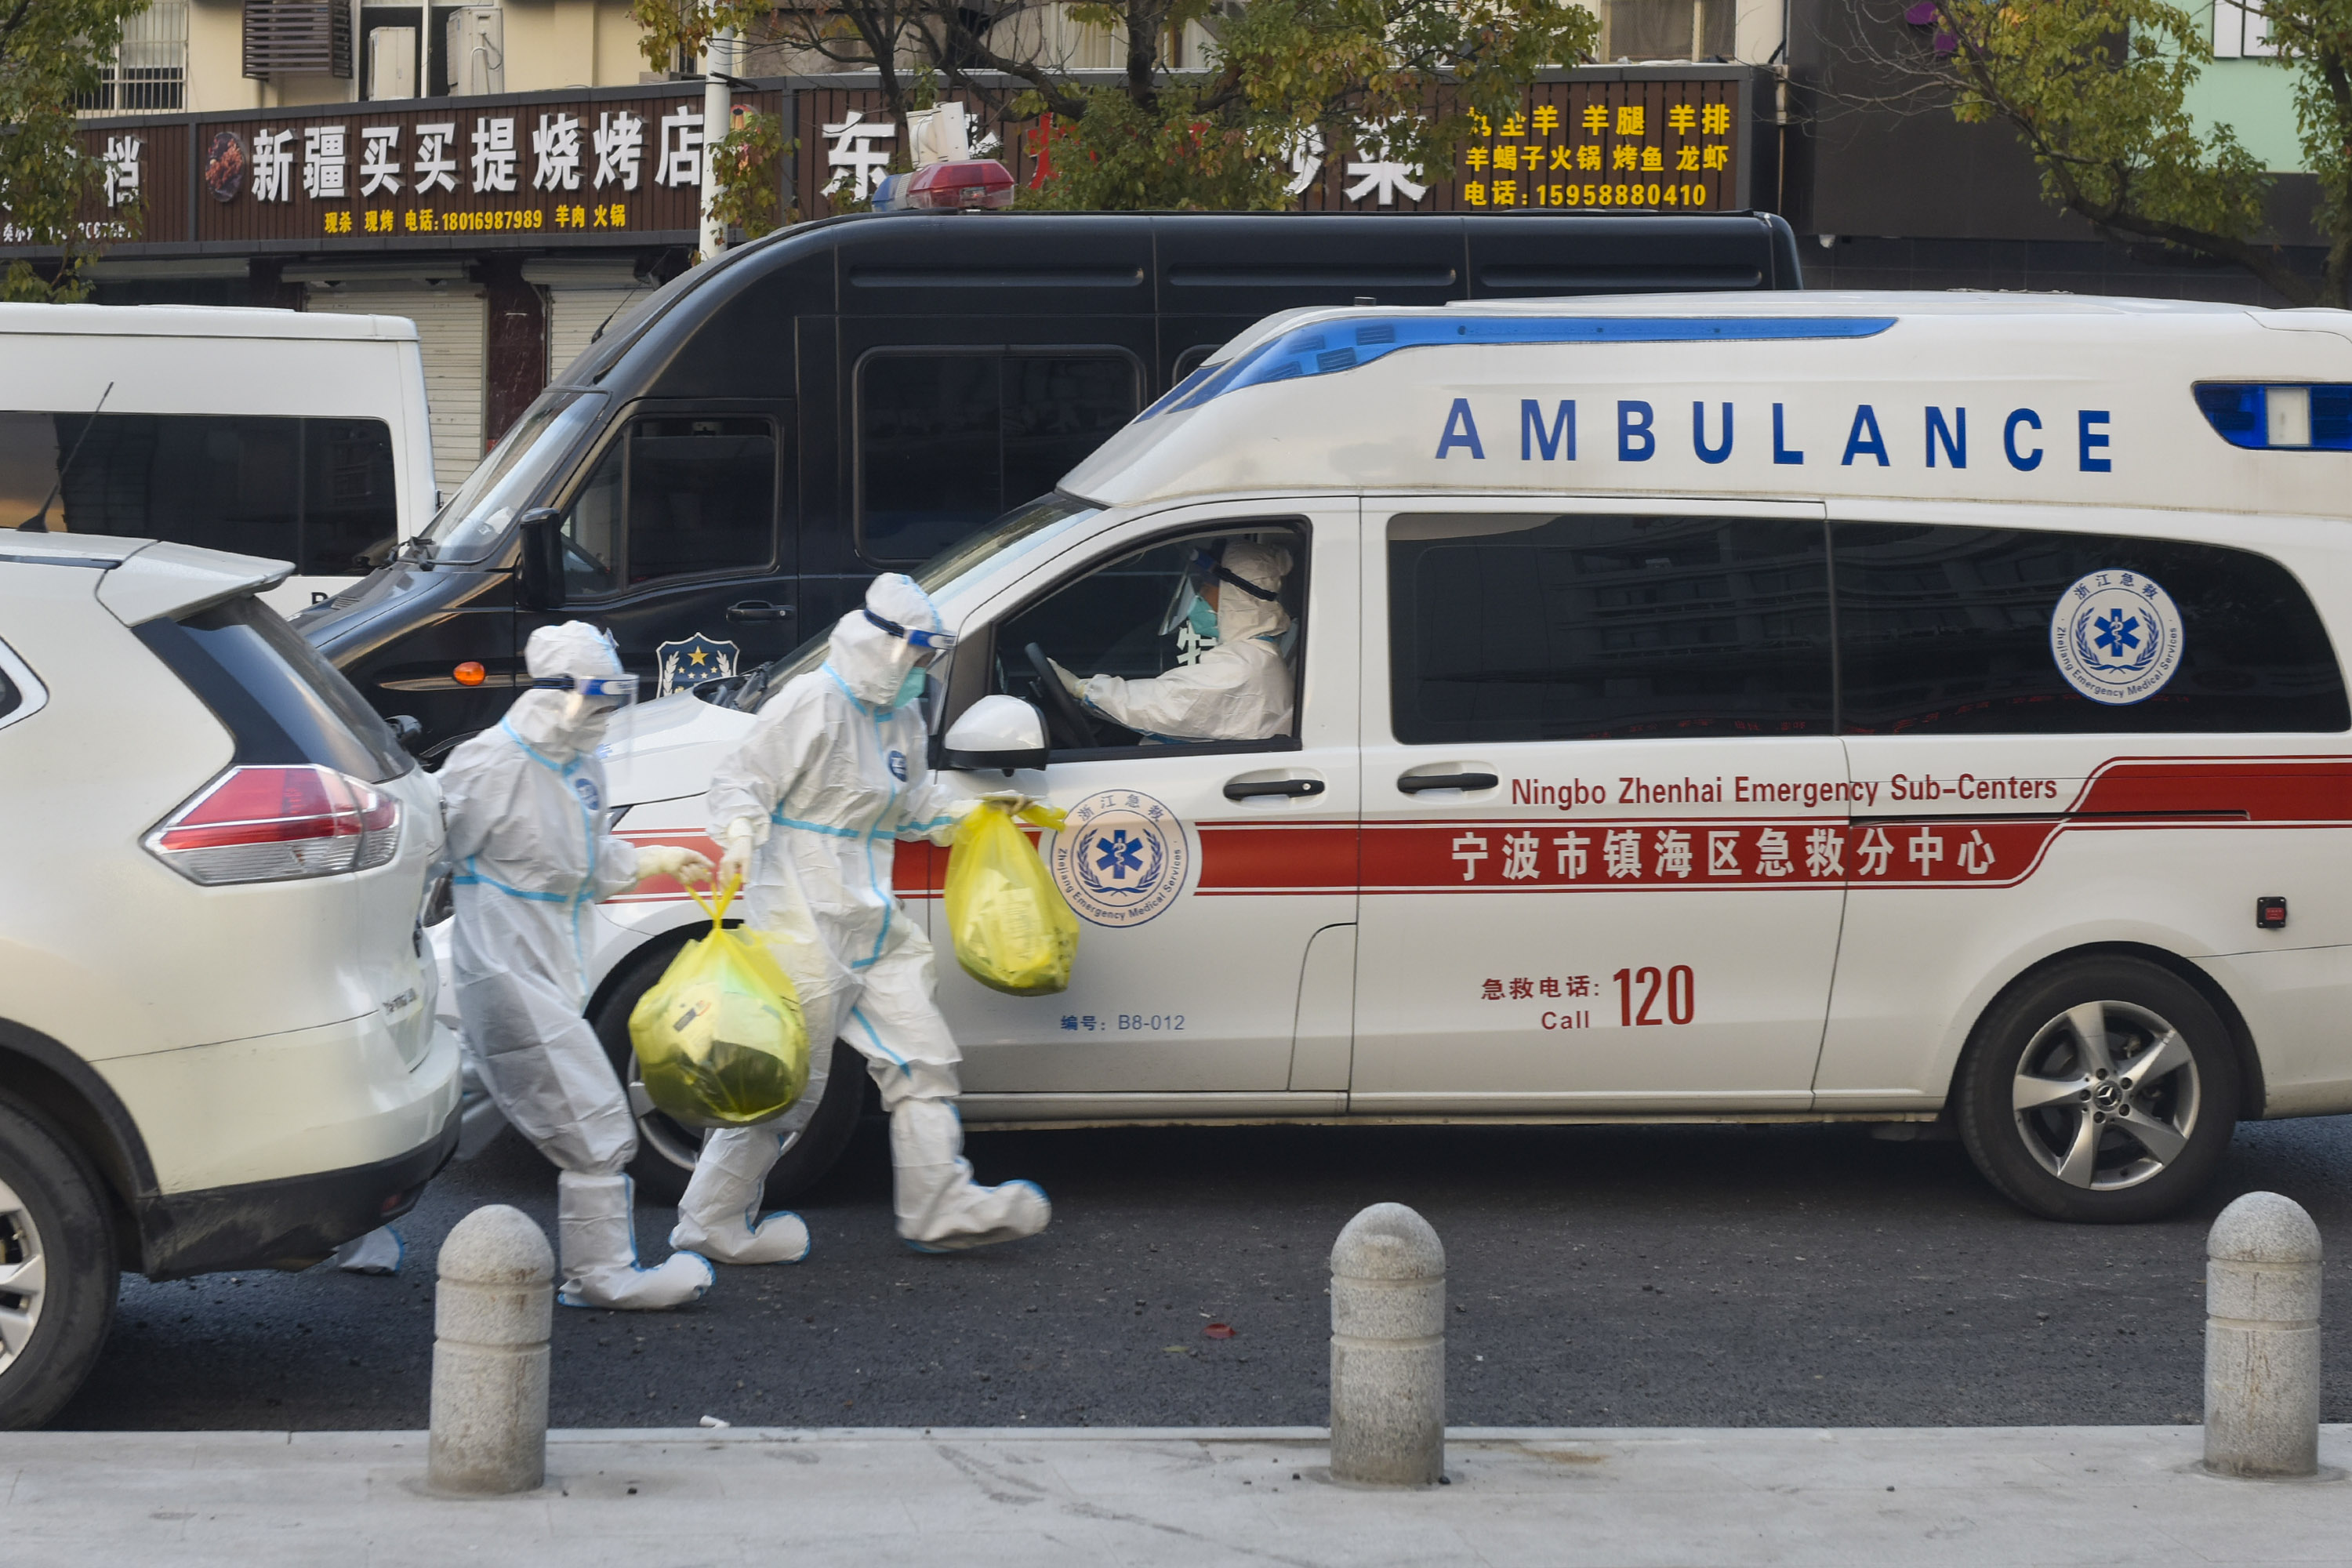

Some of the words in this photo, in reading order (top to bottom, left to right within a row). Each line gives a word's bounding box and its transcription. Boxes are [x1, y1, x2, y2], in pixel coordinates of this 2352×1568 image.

[1582, 104, 1645, 136] 羊腿
[1668, 103, 1730, 135] 羊排
[252, 105, 703, 202] 新疆买买提烧烤店
[1465, 145, 1601, 172] 羊蝎子火锅
[1612, 145, 1664, 172] 烤鱼
[1676, 144, 1730, 172] 龙虾
[325, 211, 352, 233] 现杀
[365, 209, 394, 232] 现烤
[555, 204, 585, 228] 羊肉
[593, 203, 626, 228] 火锅
[1435, 397, 2112, 473] AMBULANCE
[2073, 573, 2158, 600] 浙江急救
[2056, 627, 2074, 671] Zhejiang
[2072, 670, 2124, 698] Emergency
[2127, 670, 2164, 696] Medical
[2161, 627, 2177, 670] Services
[1077, 794, 1164, 822] 浙江急救
[1512, 778, 1606, 811] Ningbo
[1618, 776, 1722, 804] Zhenhai
[1734, 776, 1879, 808] Emergency
[1891, 773, 2057, 800] Sub-Centers
[1452, 826, 1995, 881] 宁波市镇海区急救分中心
[1058, 848, 1074, 893] Zhejiang
[1072, 891, 1125, 920] Emergency
[1128, 892, 1166, 919] Medical
[1163, 849, 1181, 892] Services
[1613, 964, 1694, 1027] 120
[1541, 1011, 1590, 1030] Call
